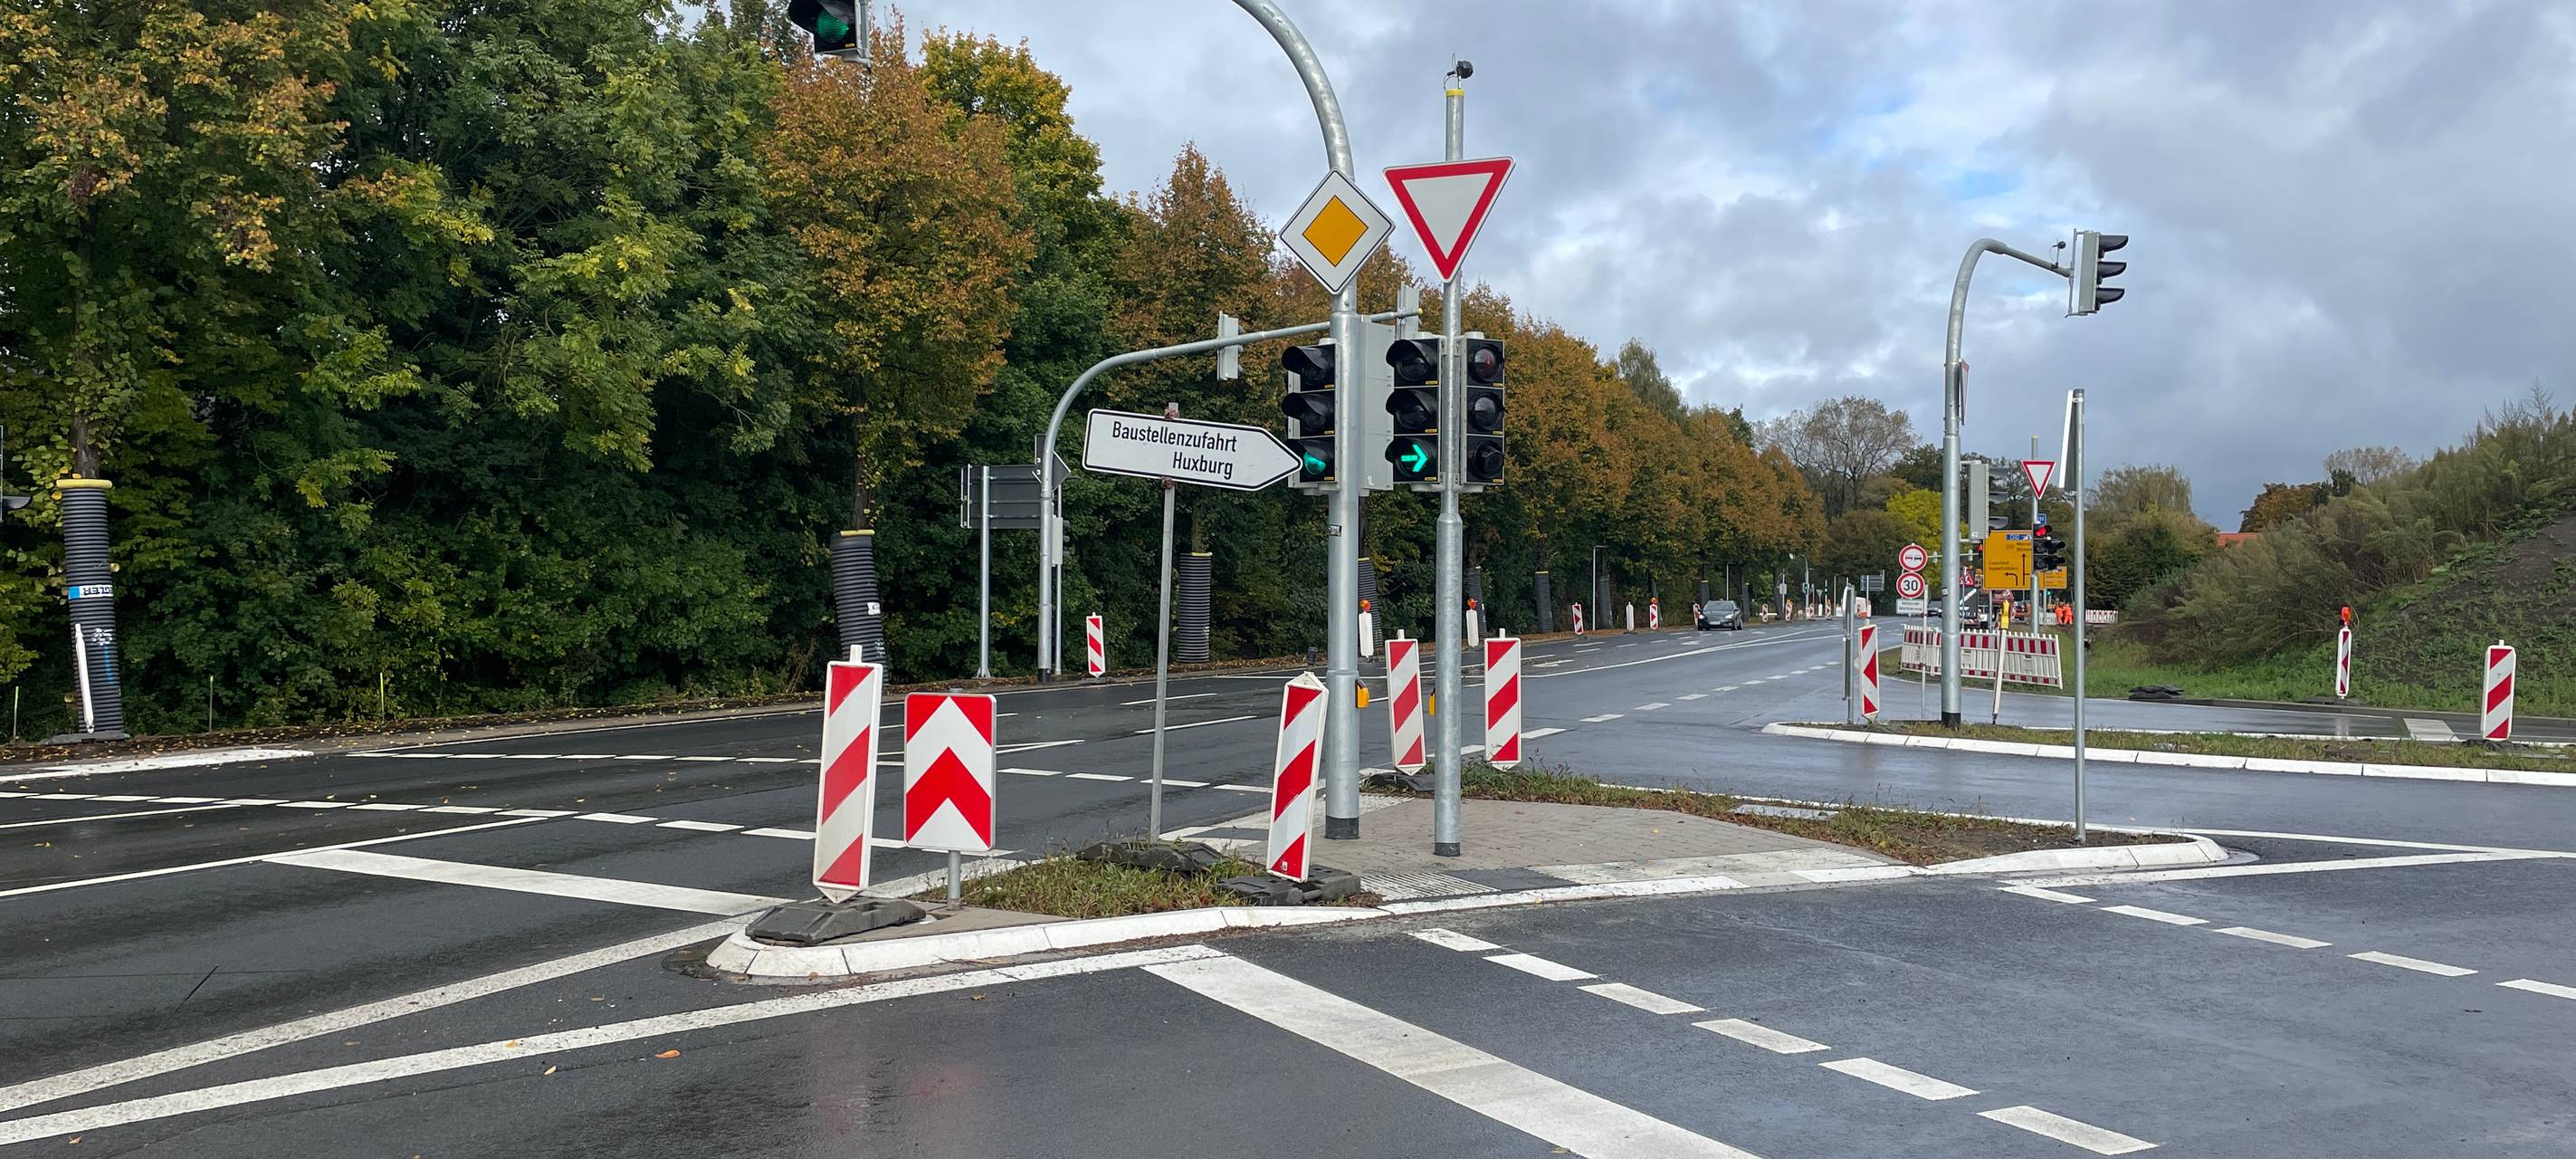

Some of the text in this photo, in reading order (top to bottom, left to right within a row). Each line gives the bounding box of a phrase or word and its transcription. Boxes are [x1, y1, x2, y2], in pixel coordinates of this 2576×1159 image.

[1112, 421, 1237, 452] Baustellenzufahrt
[1172, 451, 1234, 480] Huxburg
[1903, 580, 1918, 591] 30
